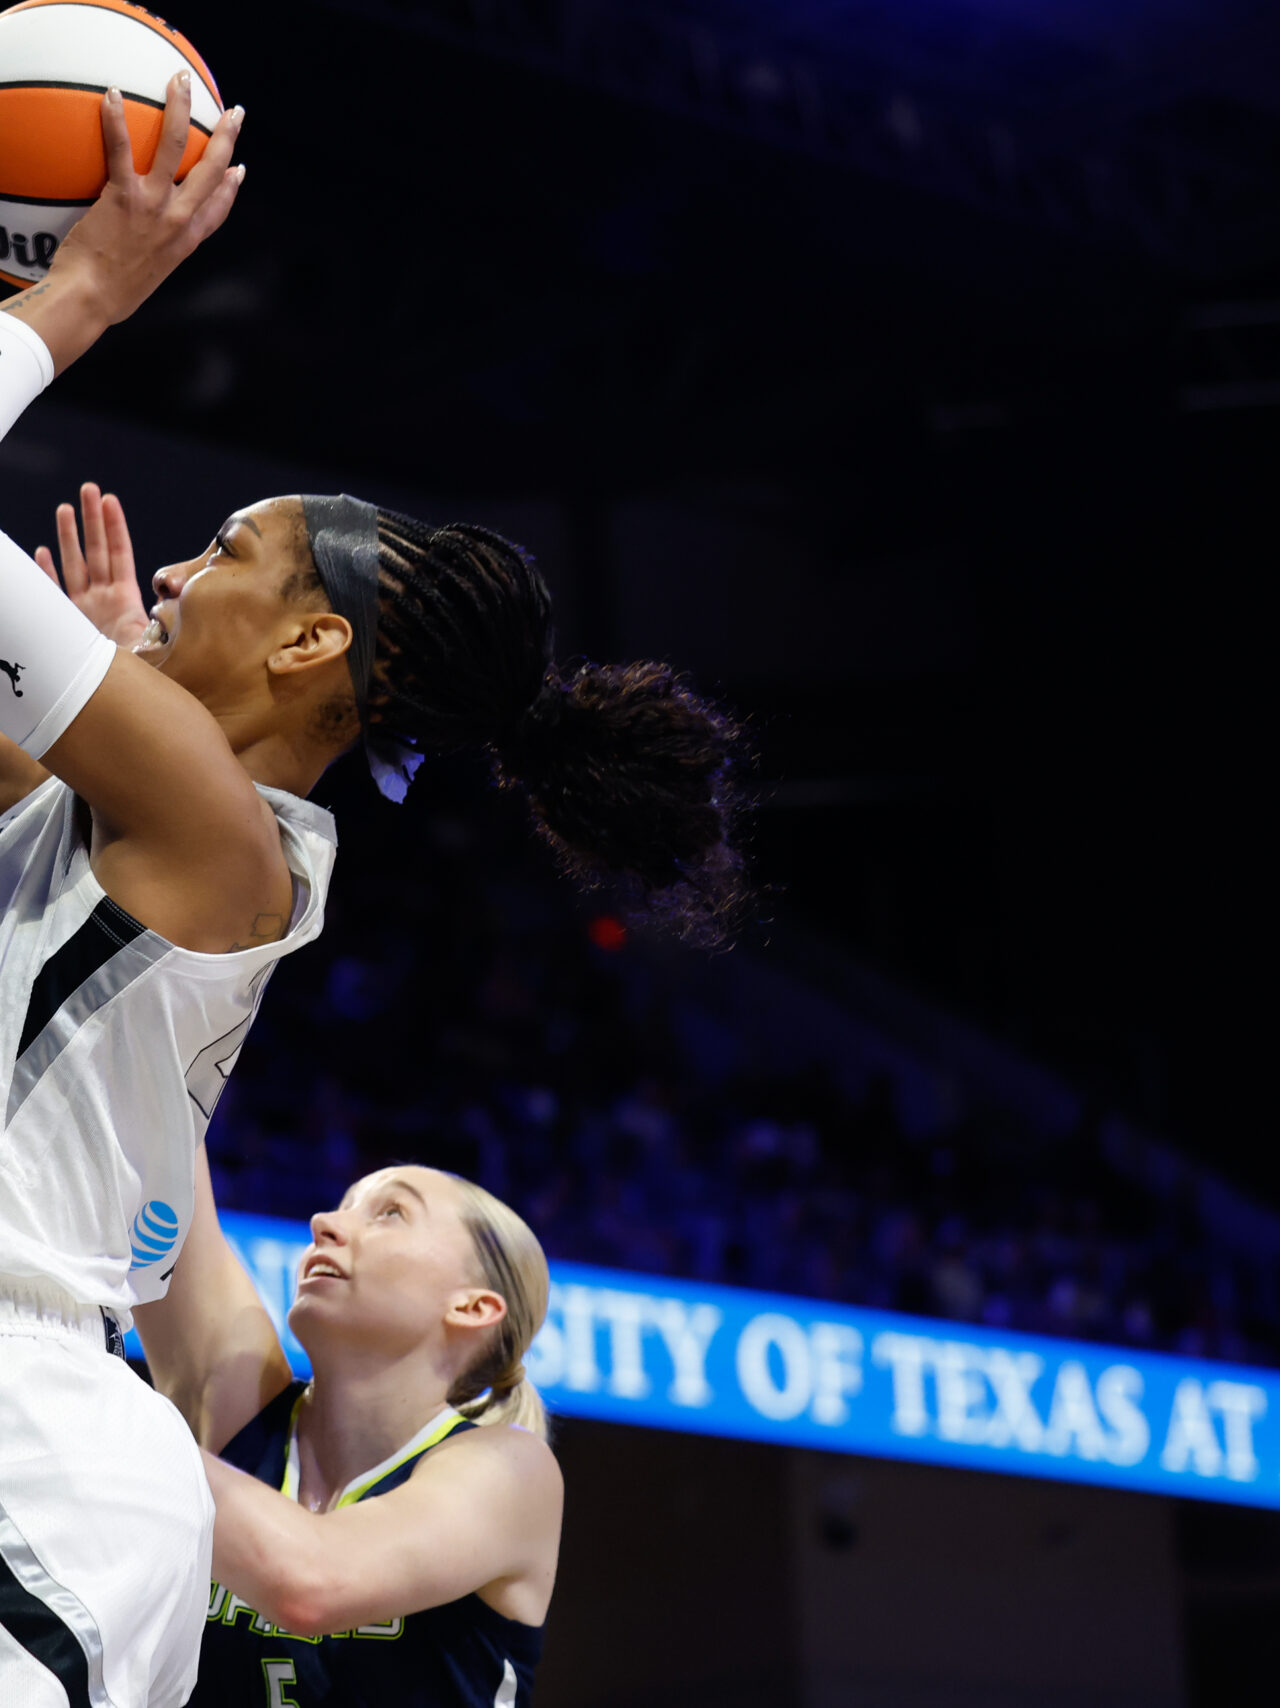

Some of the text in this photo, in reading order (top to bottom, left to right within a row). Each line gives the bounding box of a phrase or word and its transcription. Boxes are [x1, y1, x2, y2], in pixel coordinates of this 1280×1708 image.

[522, 1281, 1267, 1482] SITY OF TEXAS AT
